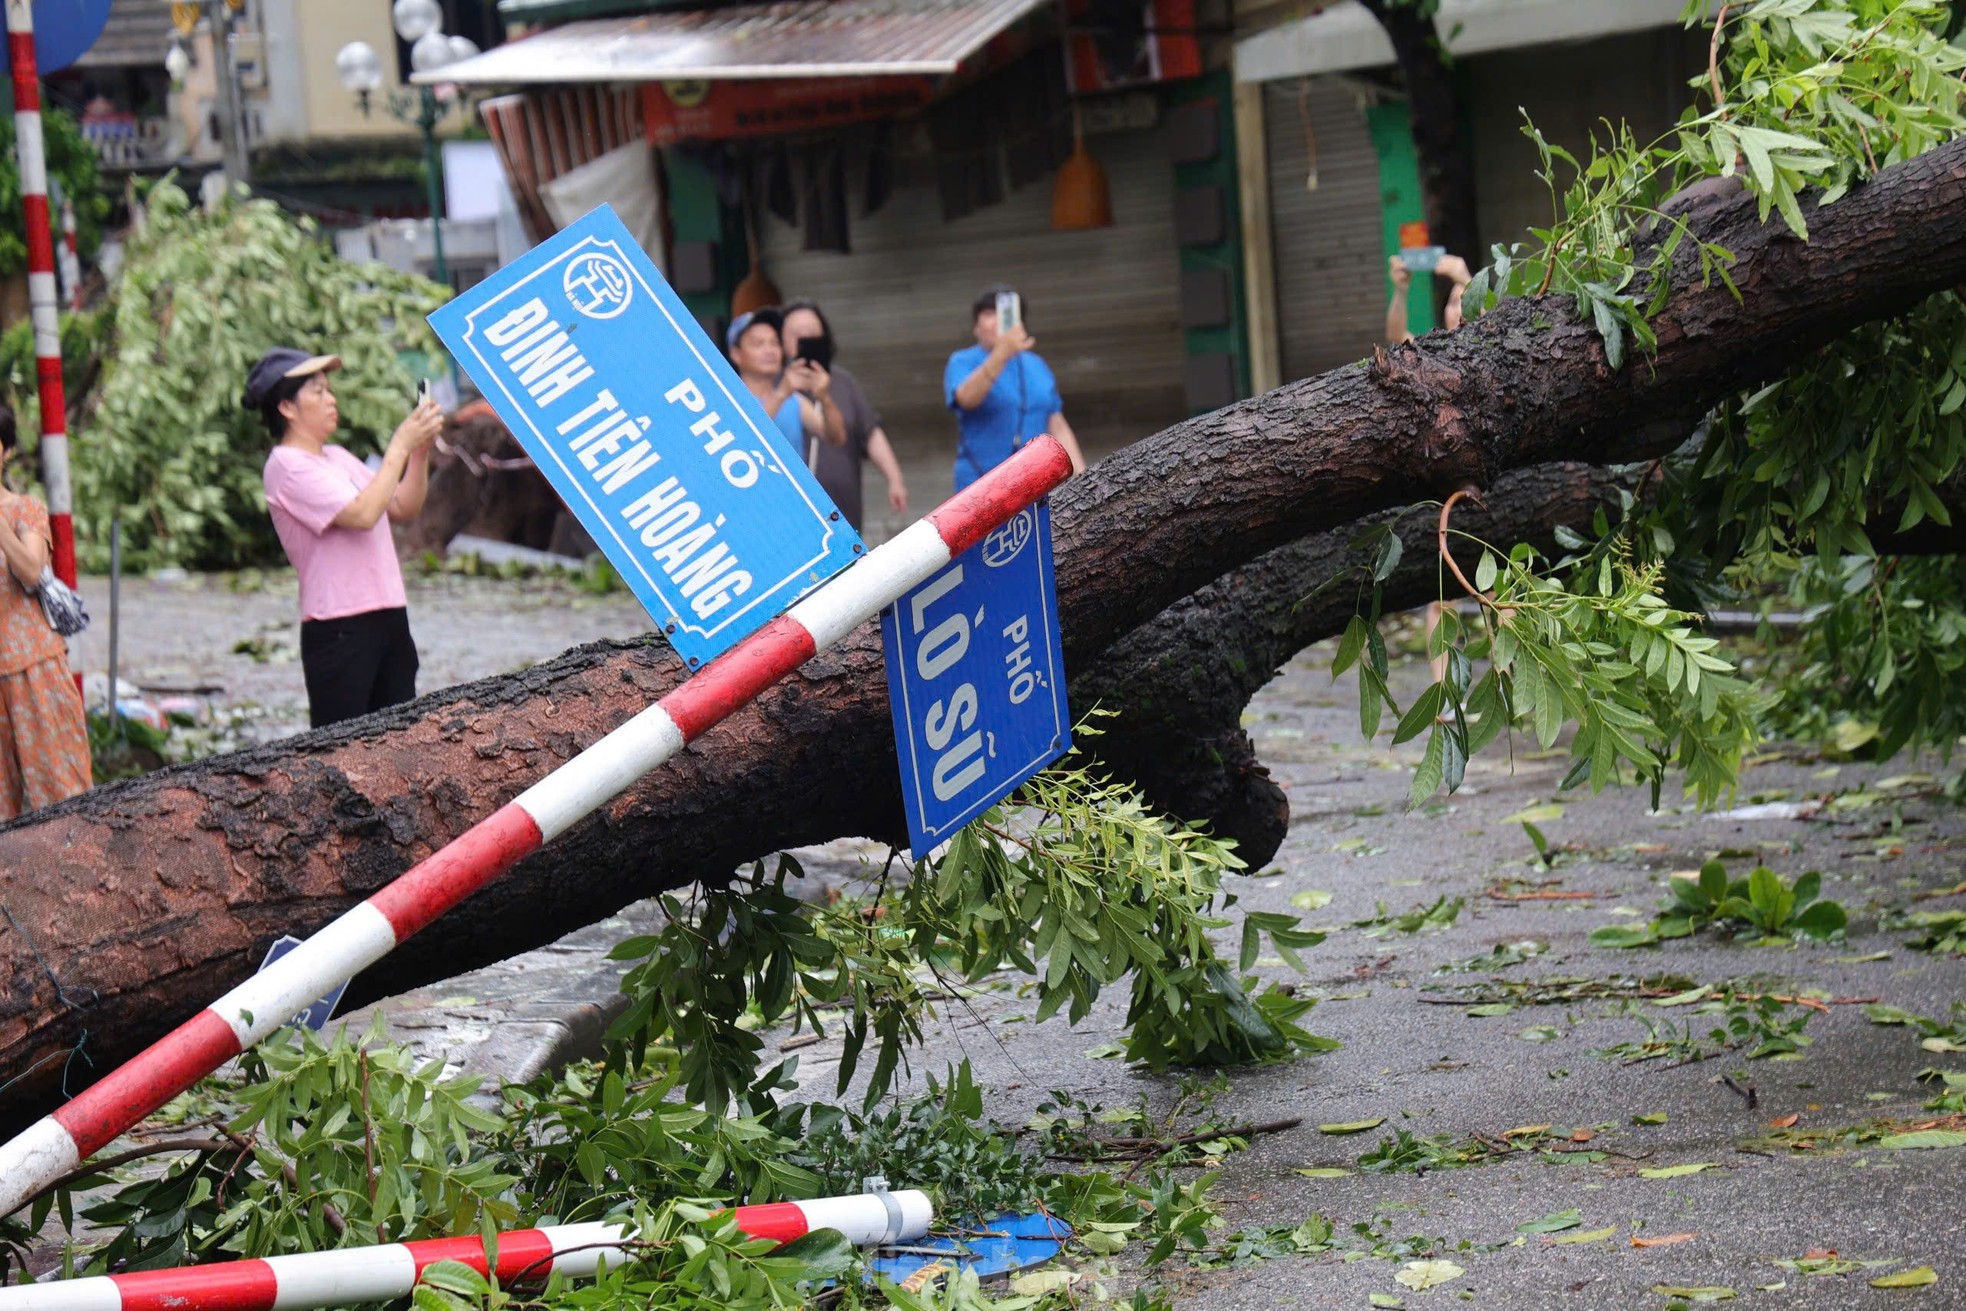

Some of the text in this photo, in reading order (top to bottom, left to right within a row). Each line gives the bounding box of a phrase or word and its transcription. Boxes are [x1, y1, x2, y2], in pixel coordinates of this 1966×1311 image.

[482, 296, 753, 621] ĐINH TIÊN HOÀNG
[663, 377, 782, 489] PHỐ
[911, 563, 998, 802] LÒ SŨ
[1002, 614, 1048, 705] PHỐ
